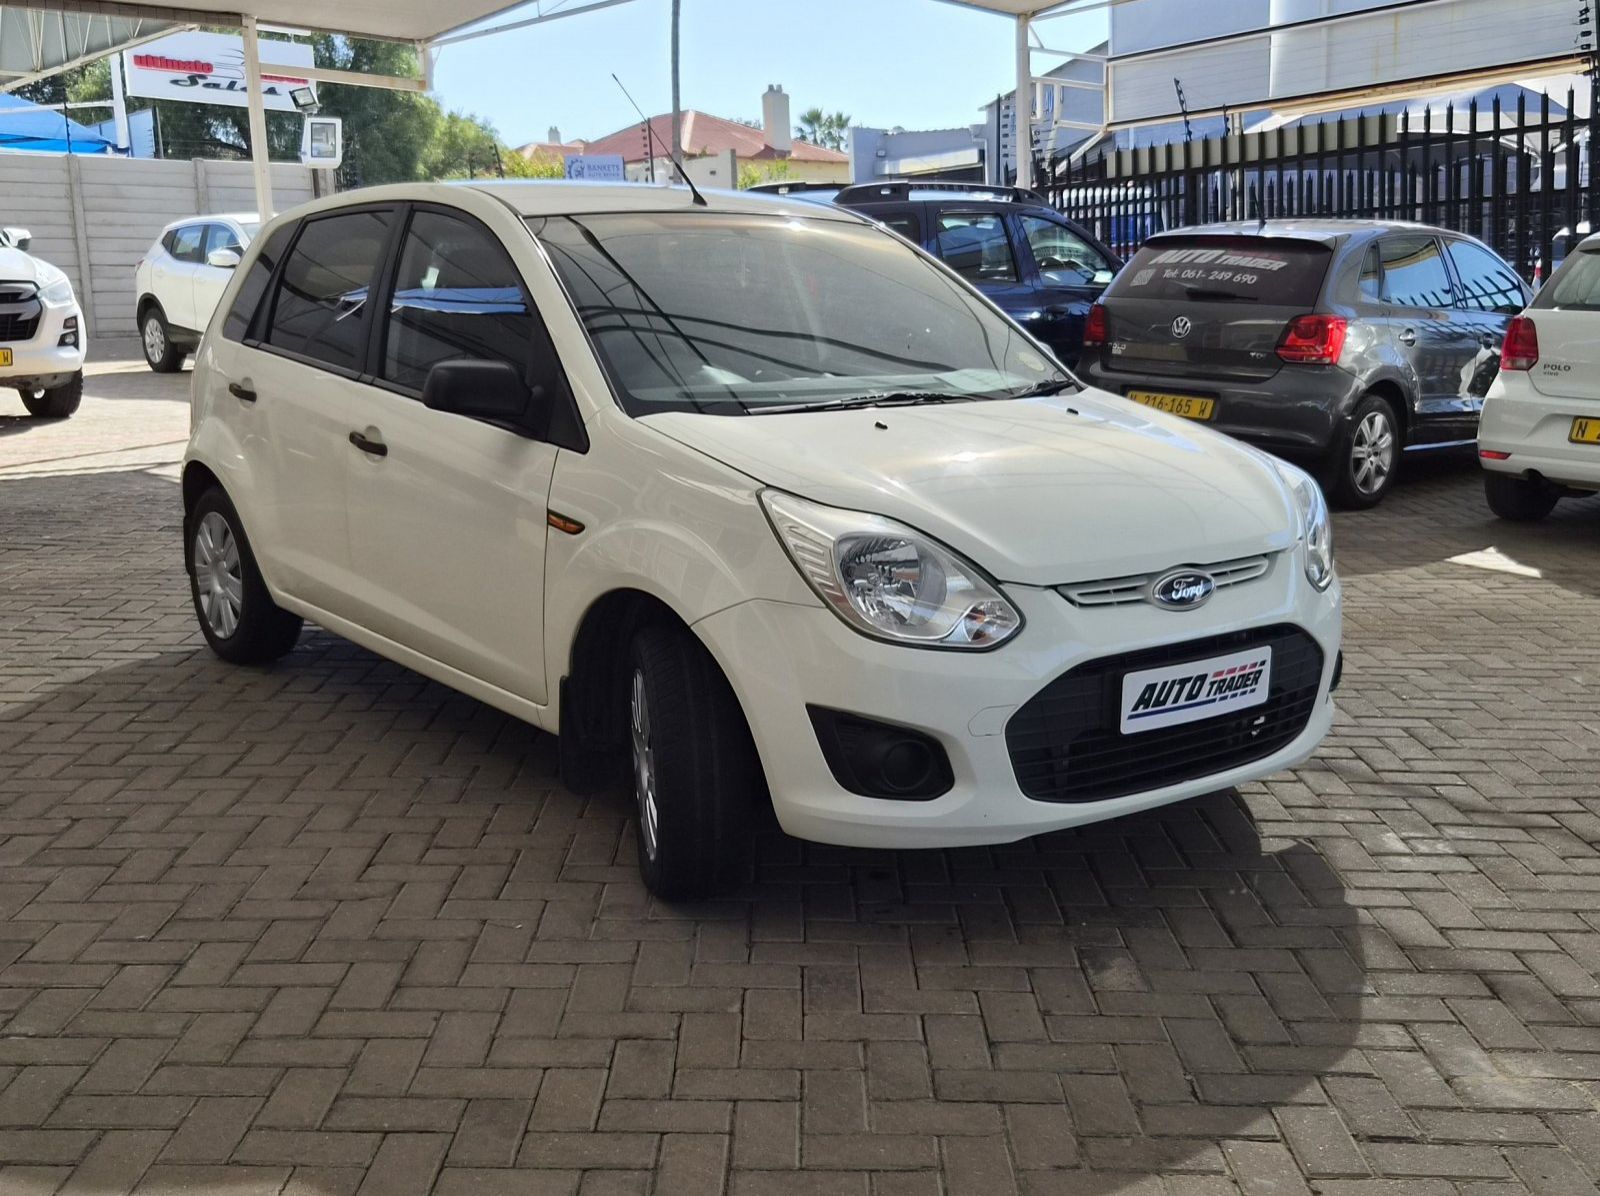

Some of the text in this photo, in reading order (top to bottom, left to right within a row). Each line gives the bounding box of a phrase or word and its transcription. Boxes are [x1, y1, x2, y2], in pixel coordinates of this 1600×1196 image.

[1149, 249, 1289, 271] AUTO TRADER
[1162, 269, 1179, 279] Tel:
[1208, 270, 1231, 281] 249
[1233, 274, 1258, 285] 690
[1543, 363, 1571, 371] POLO
[1576, 420, 1588, 438] N
[1171, 577, 1205, 600] Ford
[1131, 669, 1264, 712] AUTO TRADER
